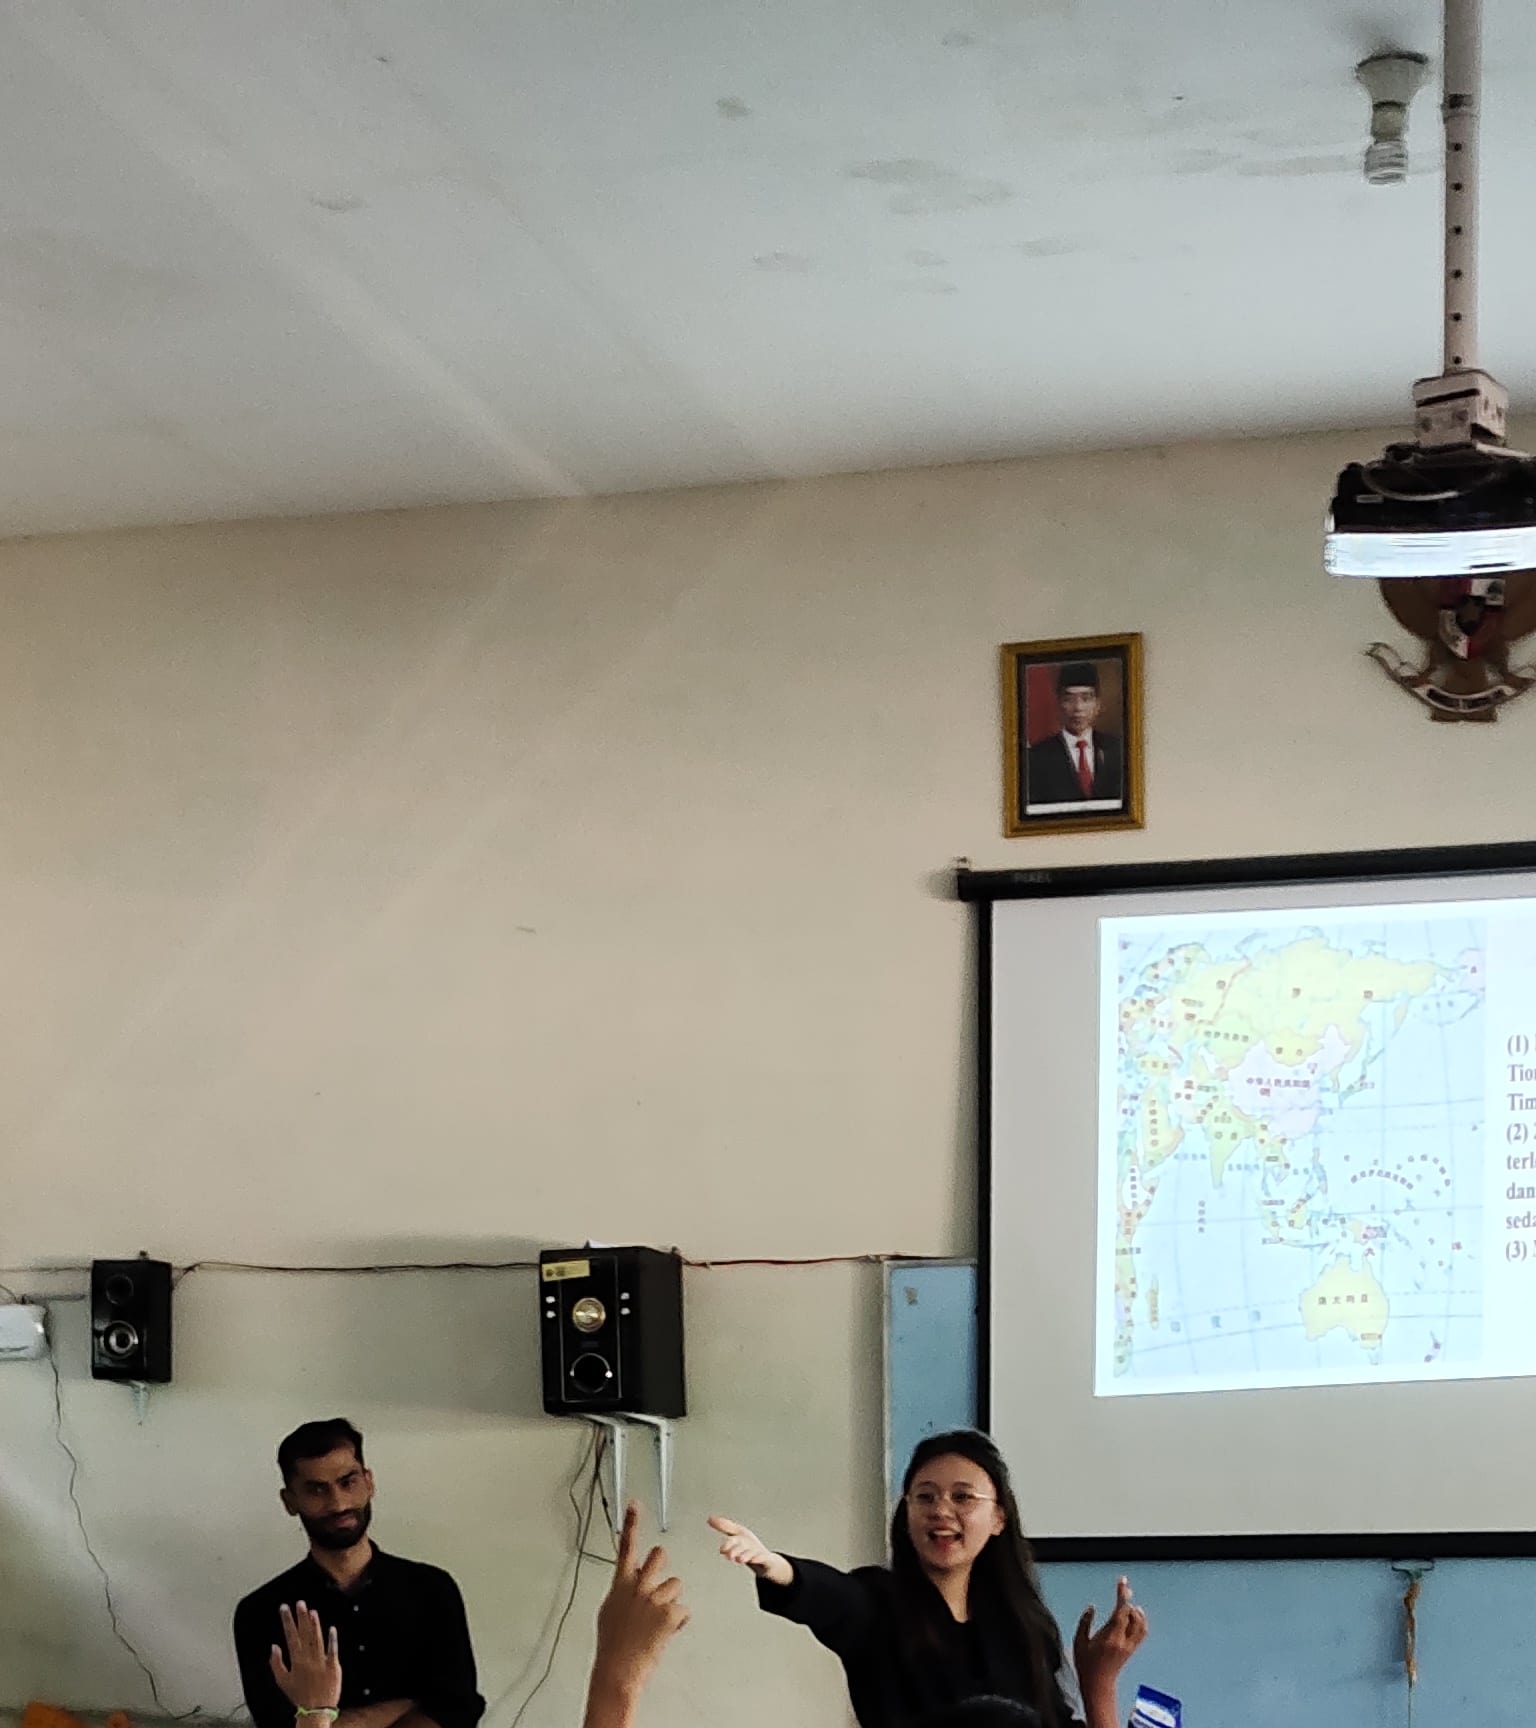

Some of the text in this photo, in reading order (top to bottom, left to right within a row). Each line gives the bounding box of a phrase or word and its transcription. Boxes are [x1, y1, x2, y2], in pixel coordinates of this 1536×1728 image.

[1507, 1035, 1530, 1057] (1)
[1506, 1122, 1529, 1145] (2)
[1506, 1182, 1536, 1201] dan
[1505, 1240, 1528, 1262] (3)
